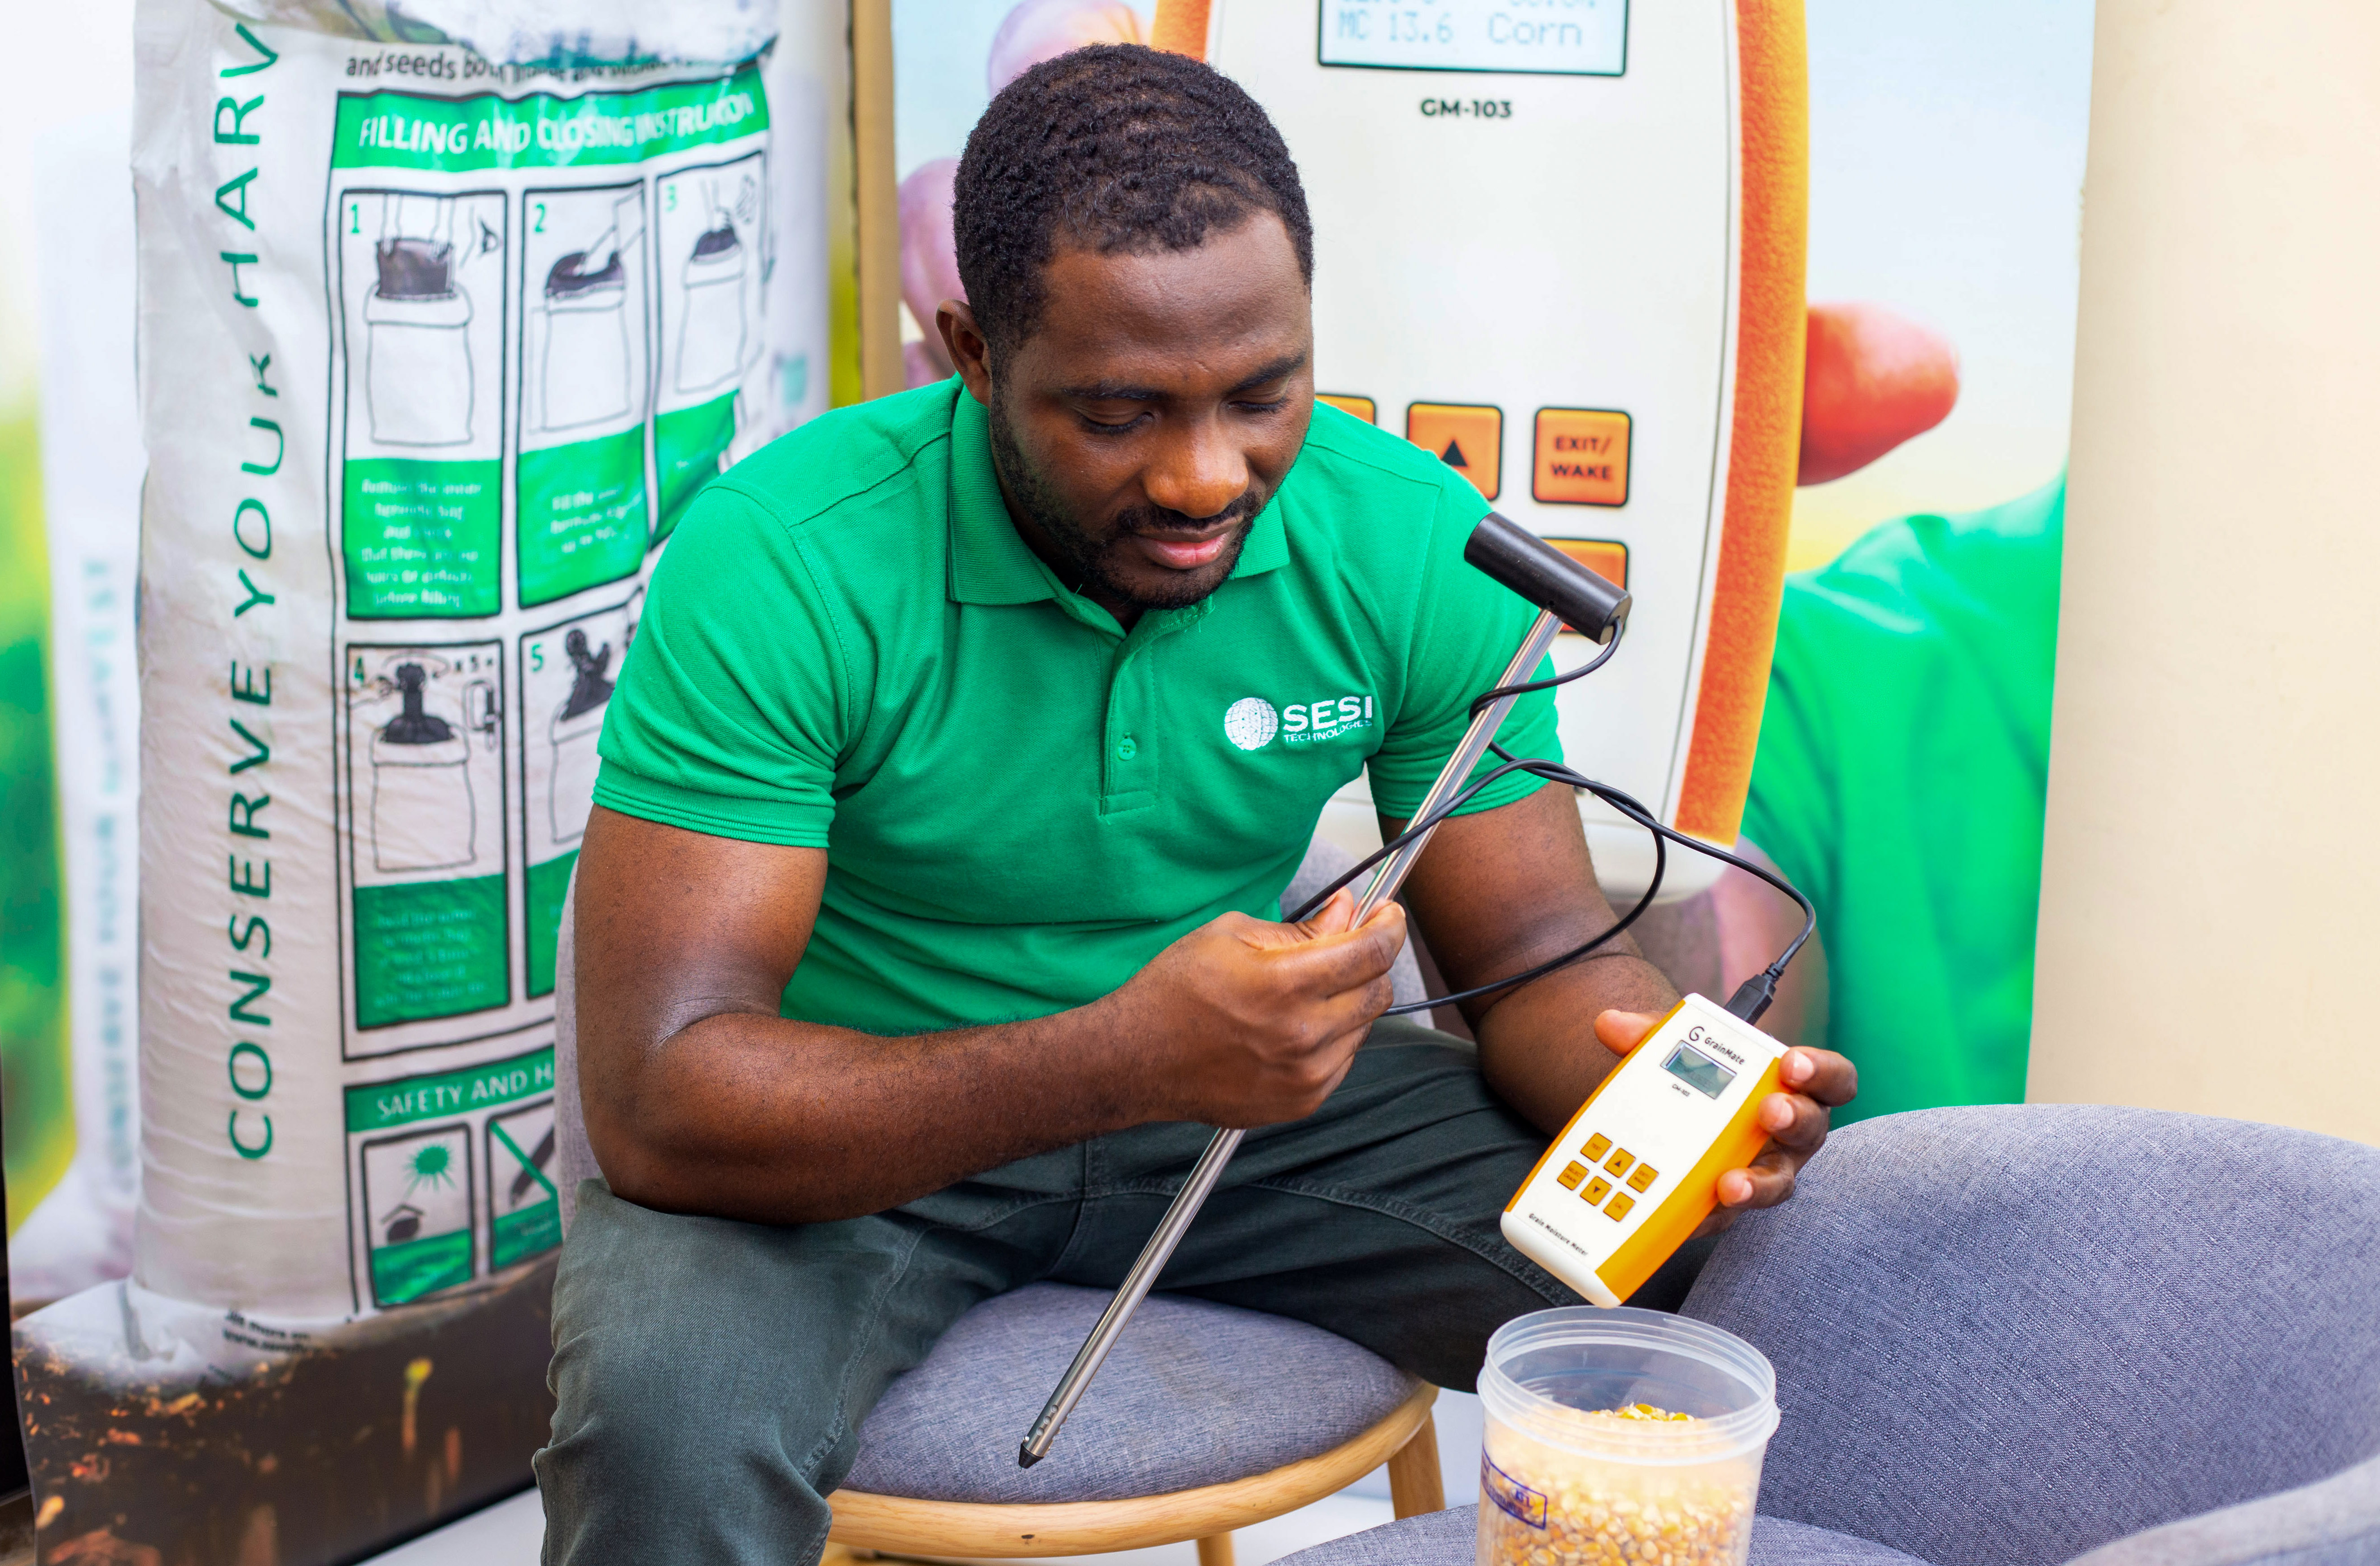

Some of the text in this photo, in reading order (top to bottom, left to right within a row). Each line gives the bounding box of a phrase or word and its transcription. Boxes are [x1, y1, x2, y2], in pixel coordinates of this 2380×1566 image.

[1338, 9, 1583, 47] MC 13.6 Corn
[384, 51, 457, 80] seeds
[1420, 98, 1513, 118] GM-103
[359, 114, 468, 155] FILLING
[473, 119, 531, 154] AND
[536, 115, 635, 151] CLOSING
[666, 184, 677, 212] 3
[350, 204, 360, 234] 1
[534, 203, 545, 233] 2
[1553, 435, 1612, 455] EXIT/
[1551, 464, 1612, 481] WAKE
[531, 635, 544, 673] 5
[1282, 695, 1373, 733] SESI
[1283, 720, 1373, 743] TECHNOLOGIES
[229, 660, 273, 1160] CONSERVE
[1704, 1037, 1745, 1065] GrainMate
[377, 1085, 463, 1122] SAFETY
[471, 1070, 528, 1102] AND
[1528, 1213, 1589, 1256] Grain Moisture Meter
